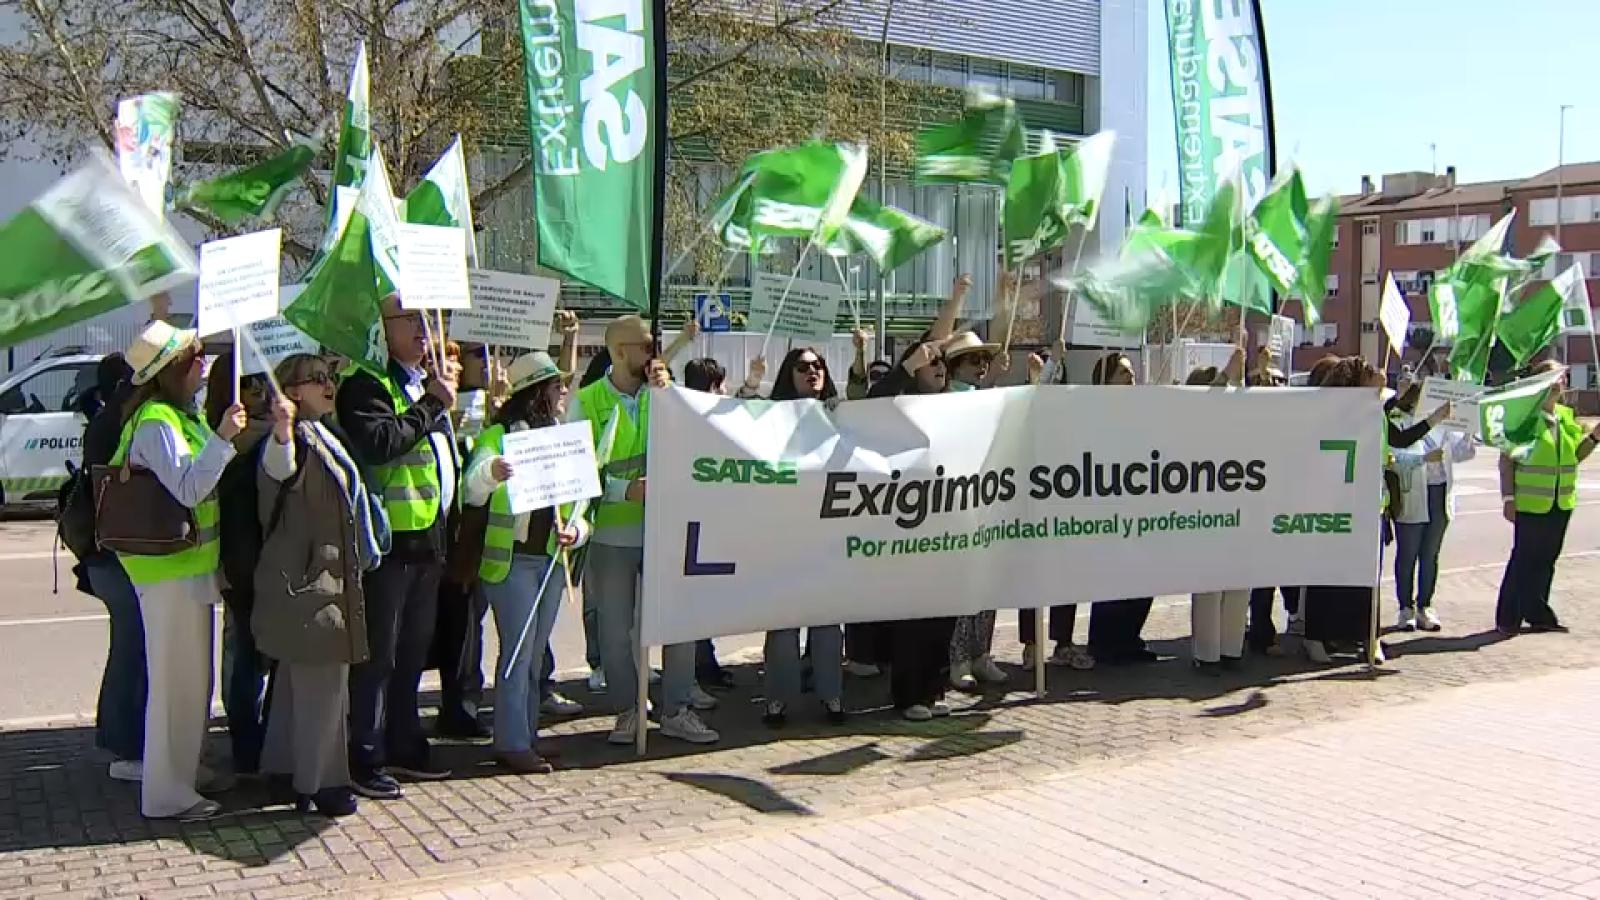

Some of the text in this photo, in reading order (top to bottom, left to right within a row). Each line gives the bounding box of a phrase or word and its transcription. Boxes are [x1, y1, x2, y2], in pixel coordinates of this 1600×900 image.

[692, 458, 799, 485] SATSE
[820, 450, 1266, 529] Exigimos soluciones
[846, 508, 1241, 559] Por nuestra dignidad laboral y profesional
[1271, 513, 1353, 534] SATSE
